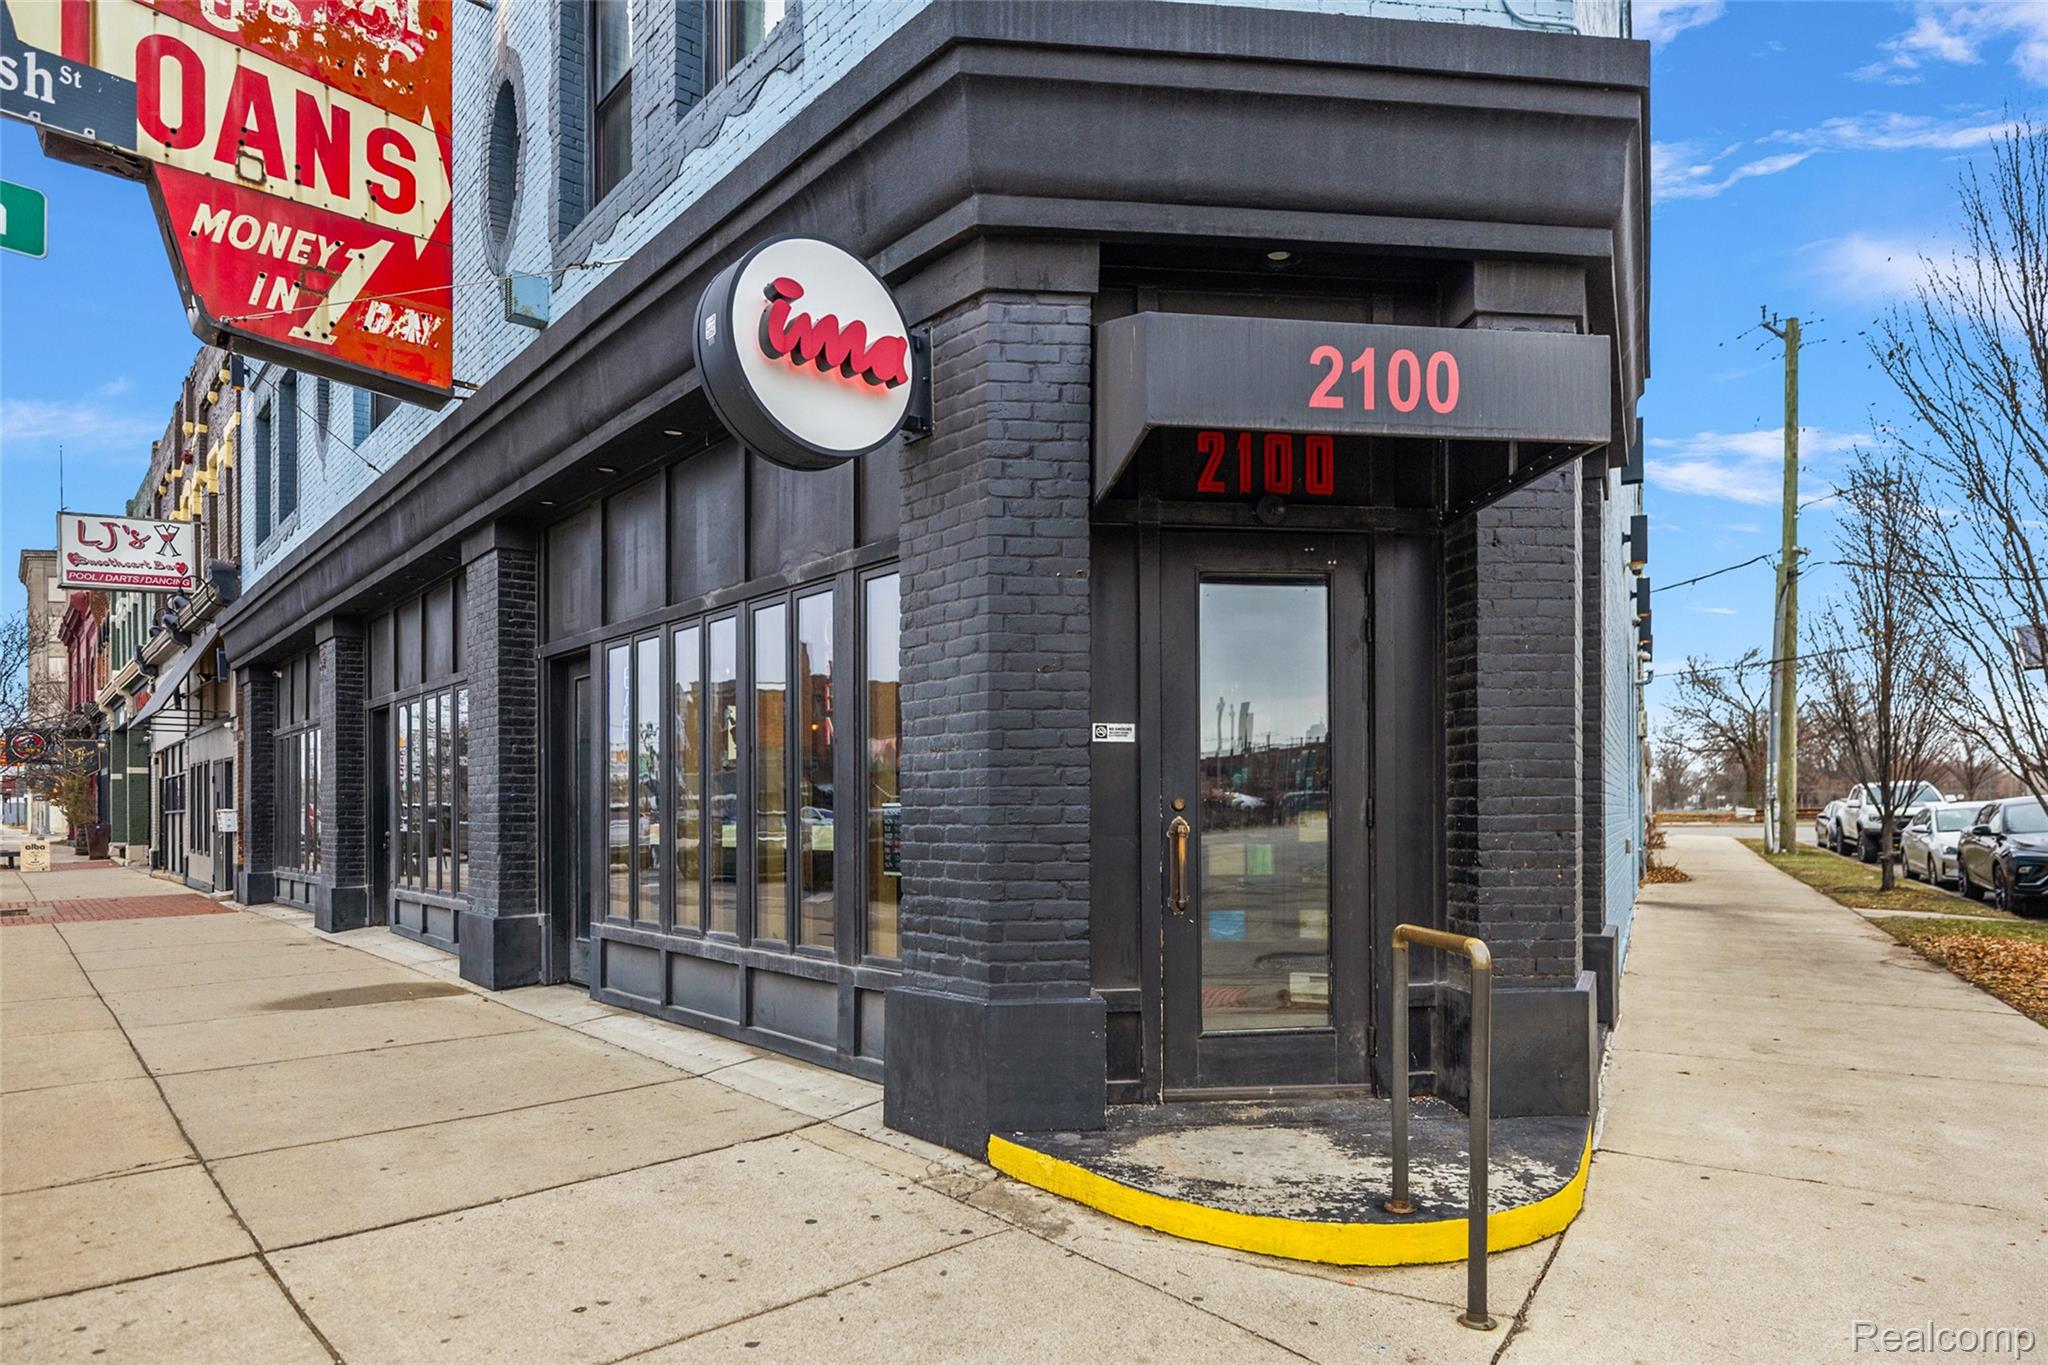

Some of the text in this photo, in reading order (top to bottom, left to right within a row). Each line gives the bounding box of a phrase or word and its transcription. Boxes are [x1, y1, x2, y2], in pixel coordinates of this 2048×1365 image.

[59, 65, 82, 89] St
[188, 202, 342, 267] MONEY
[248, 239, 446, 349] IN 1 DAY
[759, 276, 908, 389] ima
[1308, 344, 1460, 414] 2100
[1196, 431, 1334, 496] 2100
[77, 519, 151, 552] LJ's
[68, 572, 98, 581] POOL
[105, 574, 140, 584] DARTS
